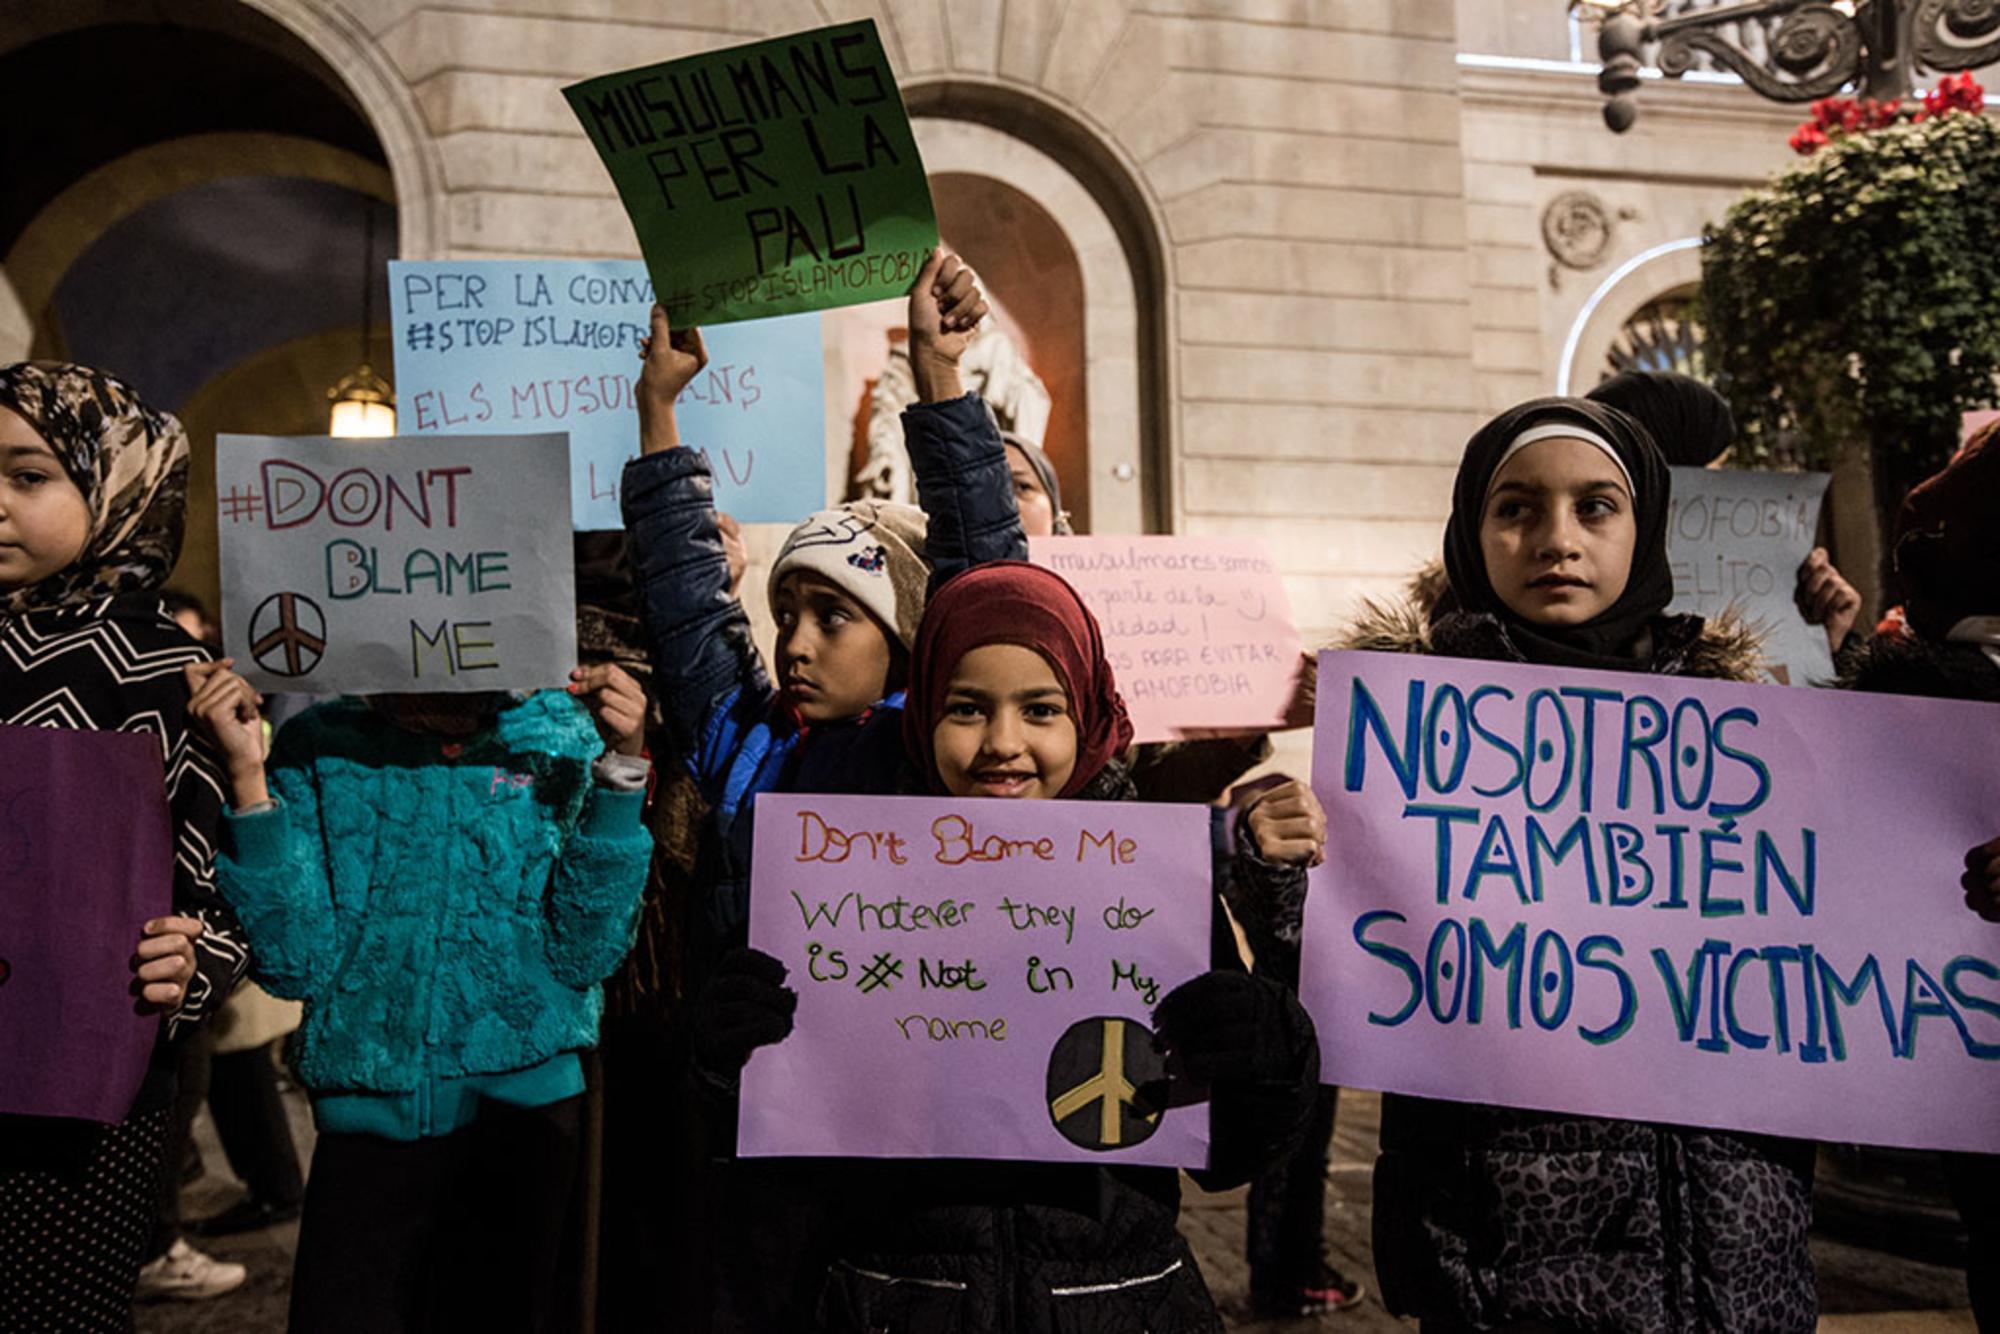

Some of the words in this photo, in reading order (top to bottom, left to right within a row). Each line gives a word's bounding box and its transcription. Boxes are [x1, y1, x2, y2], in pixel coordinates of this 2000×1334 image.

[583, 33, 887, 153] MUSULMANS
[646, 126, 779, 210] PER
[803, 114, 900, 175] LA
[745, 184, 866, 276] PAU
[404, 273, 487, 314] PER
[515, 274, 553, 307] LA
[406, 317, 515, 353] #STOP
[414, 382, 494, 430] ELS
[511, 364, 762, 420] MUSULANS
[325, 538, 512, 600] BLAME
[409, 618, 500, 679] ME
[1200, 644, 1282, 664] EVITAR
[1344, 676, 1772, 818] NOSOTROS
[795, 810, 907, 863] Don't
[1077, 829, 1138, 865] Me
[1402, 804, 1816, 917] TAMBIÉN
[790, 889, 976, 932] Whatever
[998, 896, 1076, 944] they
[1103, 897, 1155, 930] do
[806, 943, 849, 982] is
[919, 957, 987, 992] Not
[1026, 956, 1074, 992] in
[1111, 958, 1160, 1005] My
[1352, 909, 1640, 1046] SOMOS
[1650, 938, 2000, 1064] VICTIMAS
[895, 1014, 1008, 1042] name
